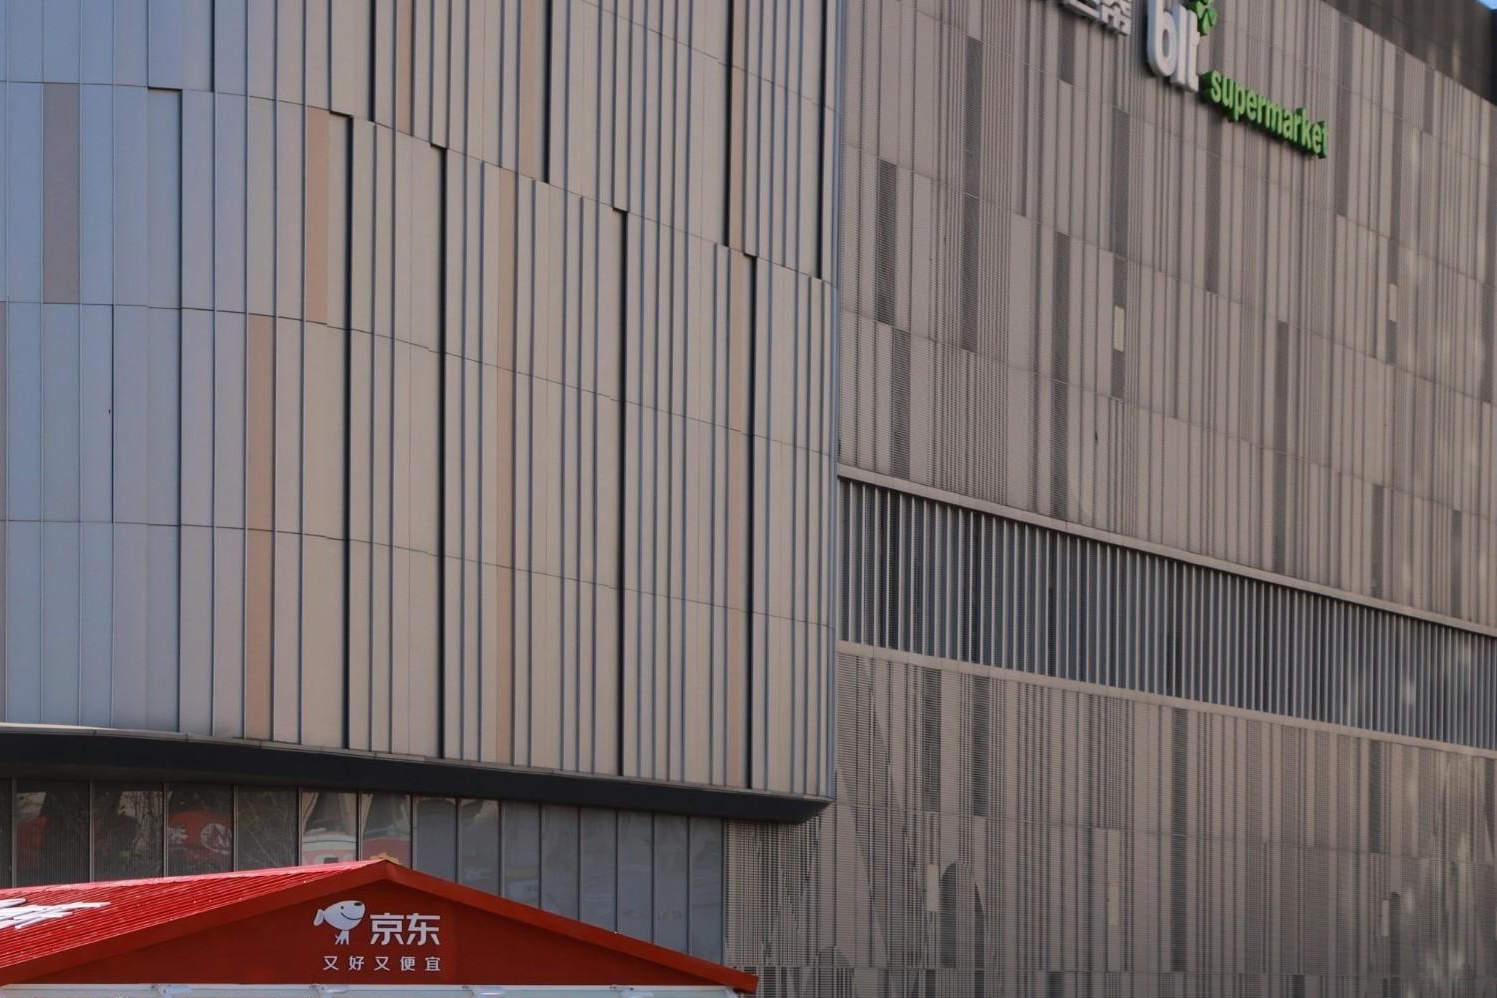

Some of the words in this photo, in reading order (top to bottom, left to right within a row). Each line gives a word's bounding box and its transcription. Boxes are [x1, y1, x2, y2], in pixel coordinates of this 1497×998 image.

[1206, 69, 1328, 158] supermarket
[369, 911, 441, 946] 京东
[322, 955, 442, 972] 又好又便宜
